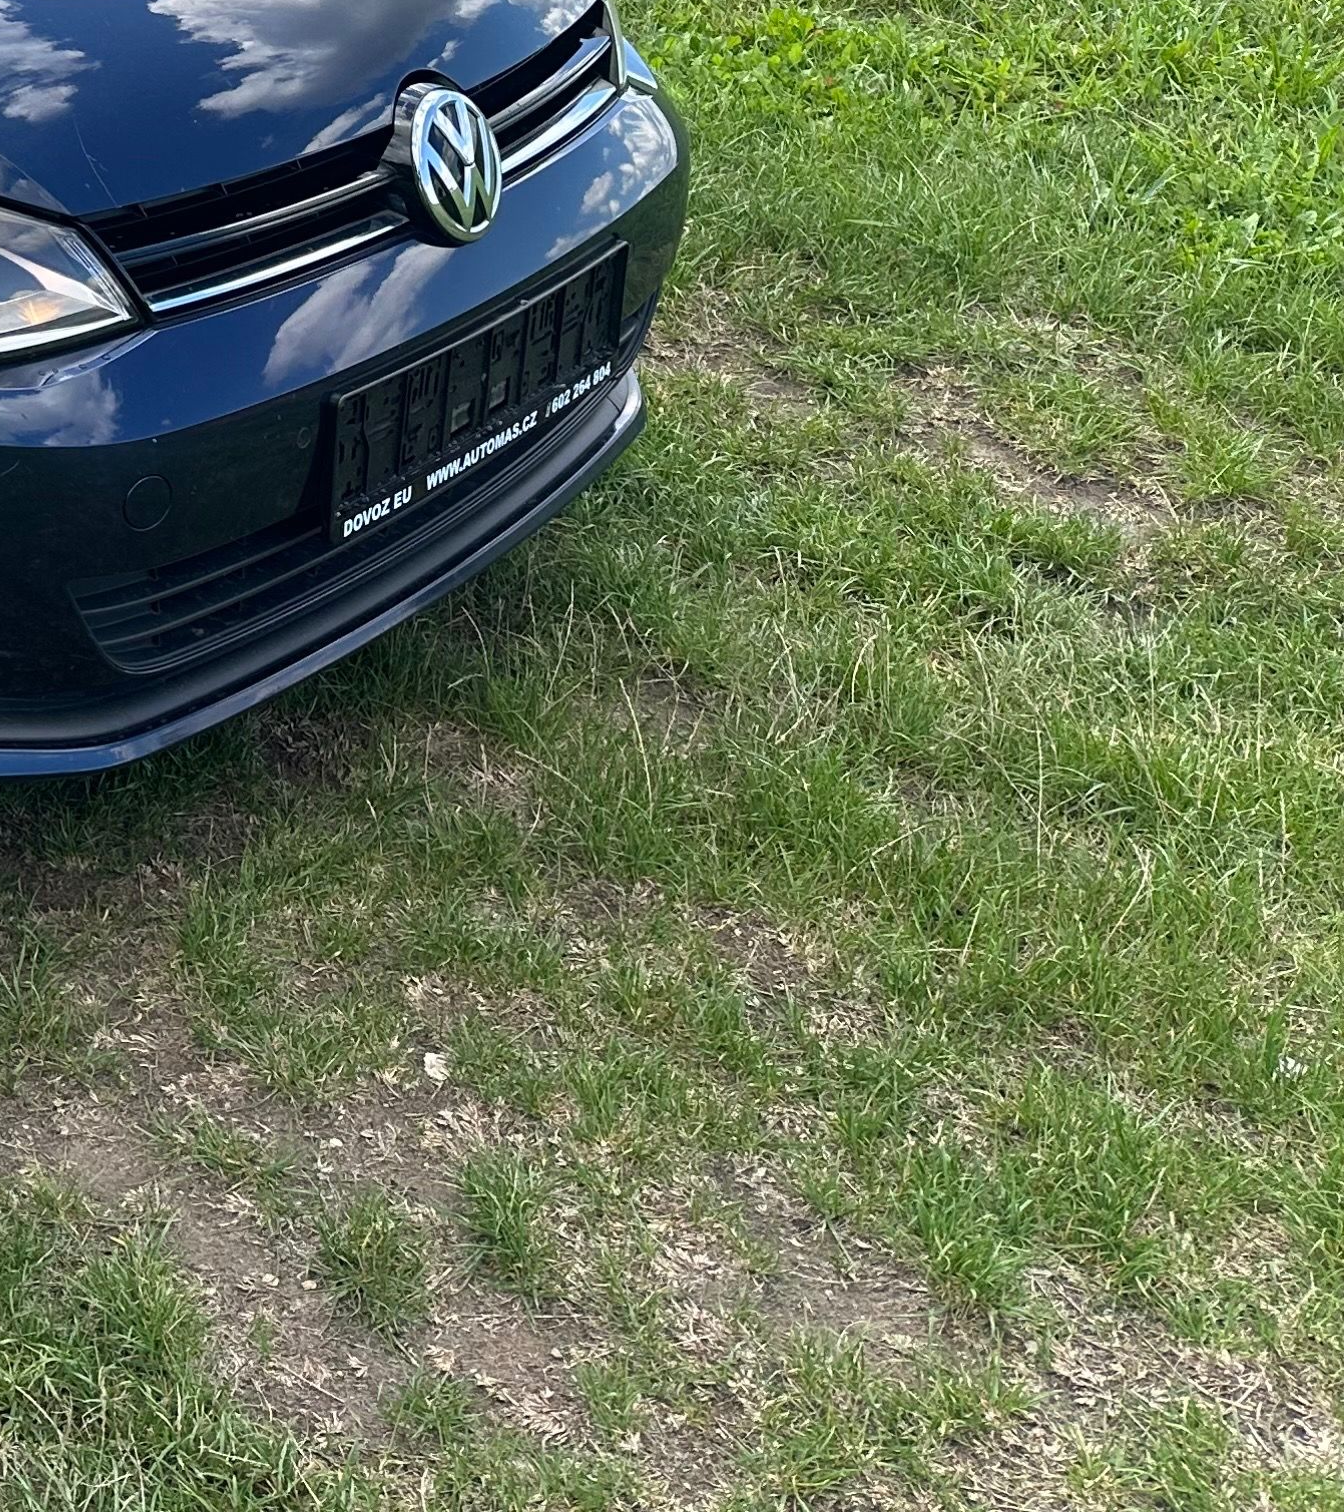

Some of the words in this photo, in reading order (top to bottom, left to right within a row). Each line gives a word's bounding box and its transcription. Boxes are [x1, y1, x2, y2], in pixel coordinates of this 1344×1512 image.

[343, 496, 391, 537] DOVOZ
[393, 486, 413, 508] EU
[426, 410, 538, 491] WWW.AUTOMAS.CZ
[572, 374, 592, 400] 264
[593, 361, 612, 385] 804
